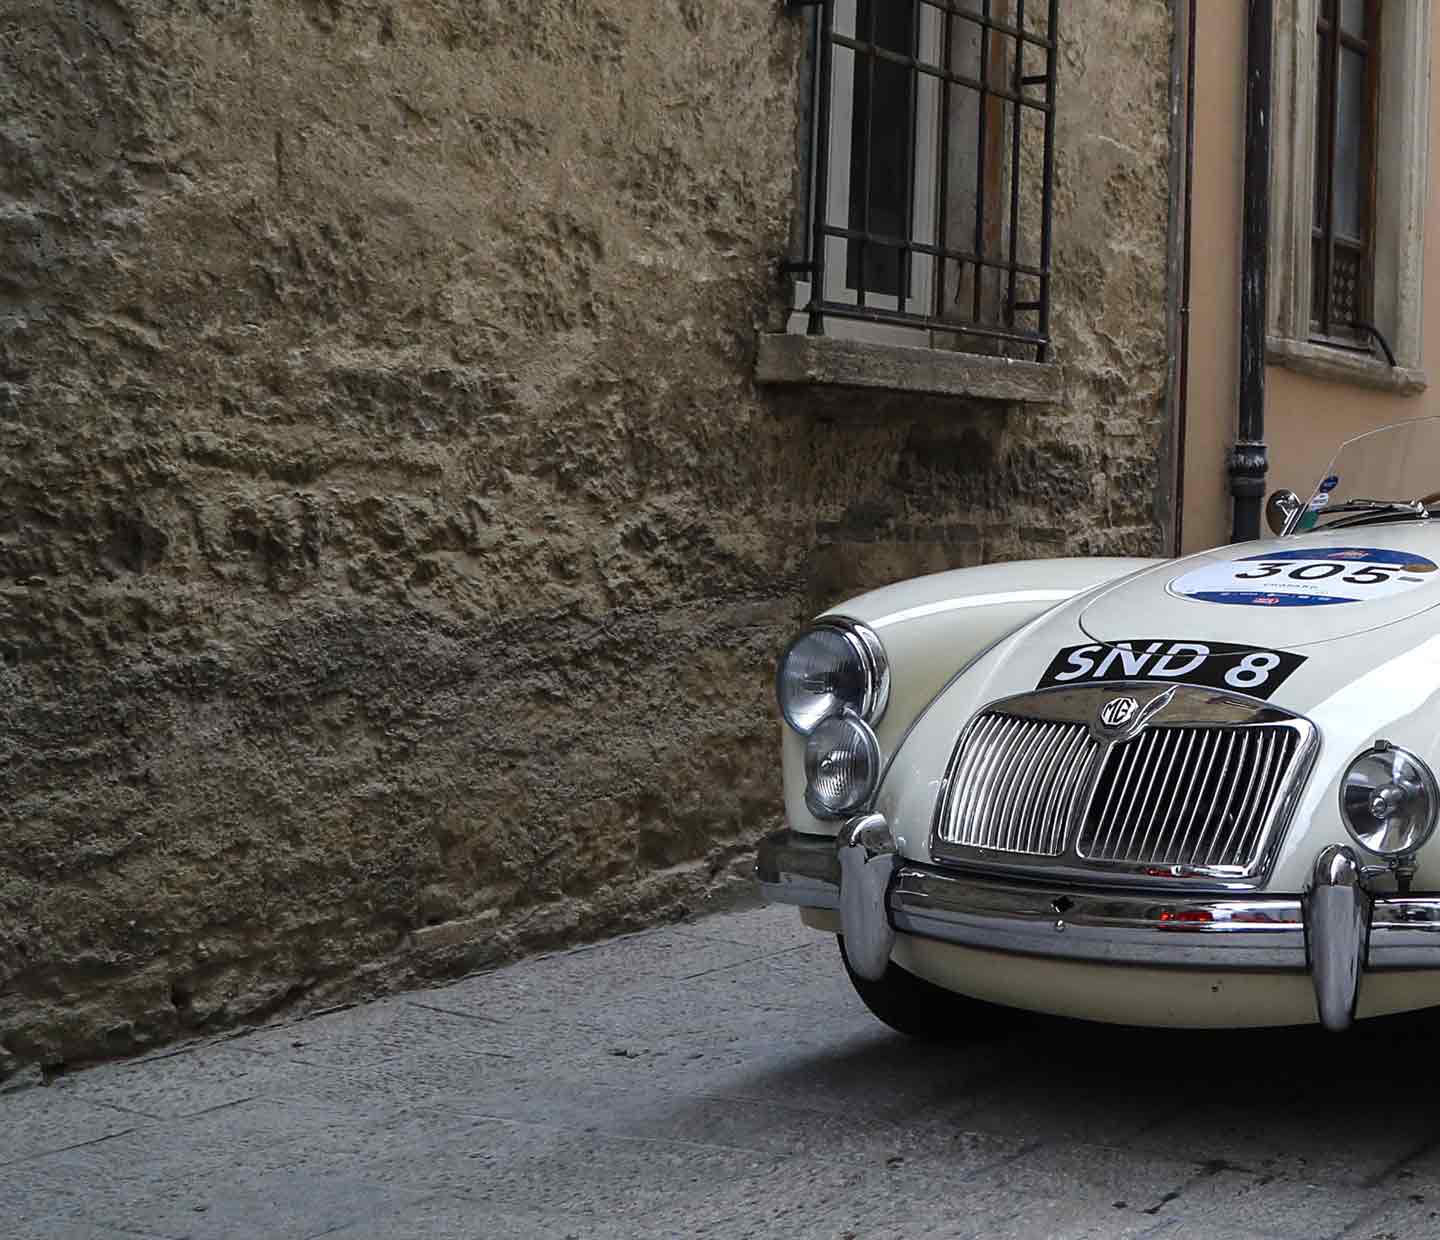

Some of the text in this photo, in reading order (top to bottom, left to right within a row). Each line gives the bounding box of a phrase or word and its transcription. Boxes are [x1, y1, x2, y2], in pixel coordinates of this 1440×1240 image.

[1235, 562, 1400, 584] 305
[1054, 643, 1281, 688] SND 8
[1102, 698, 1132, 724] MG
